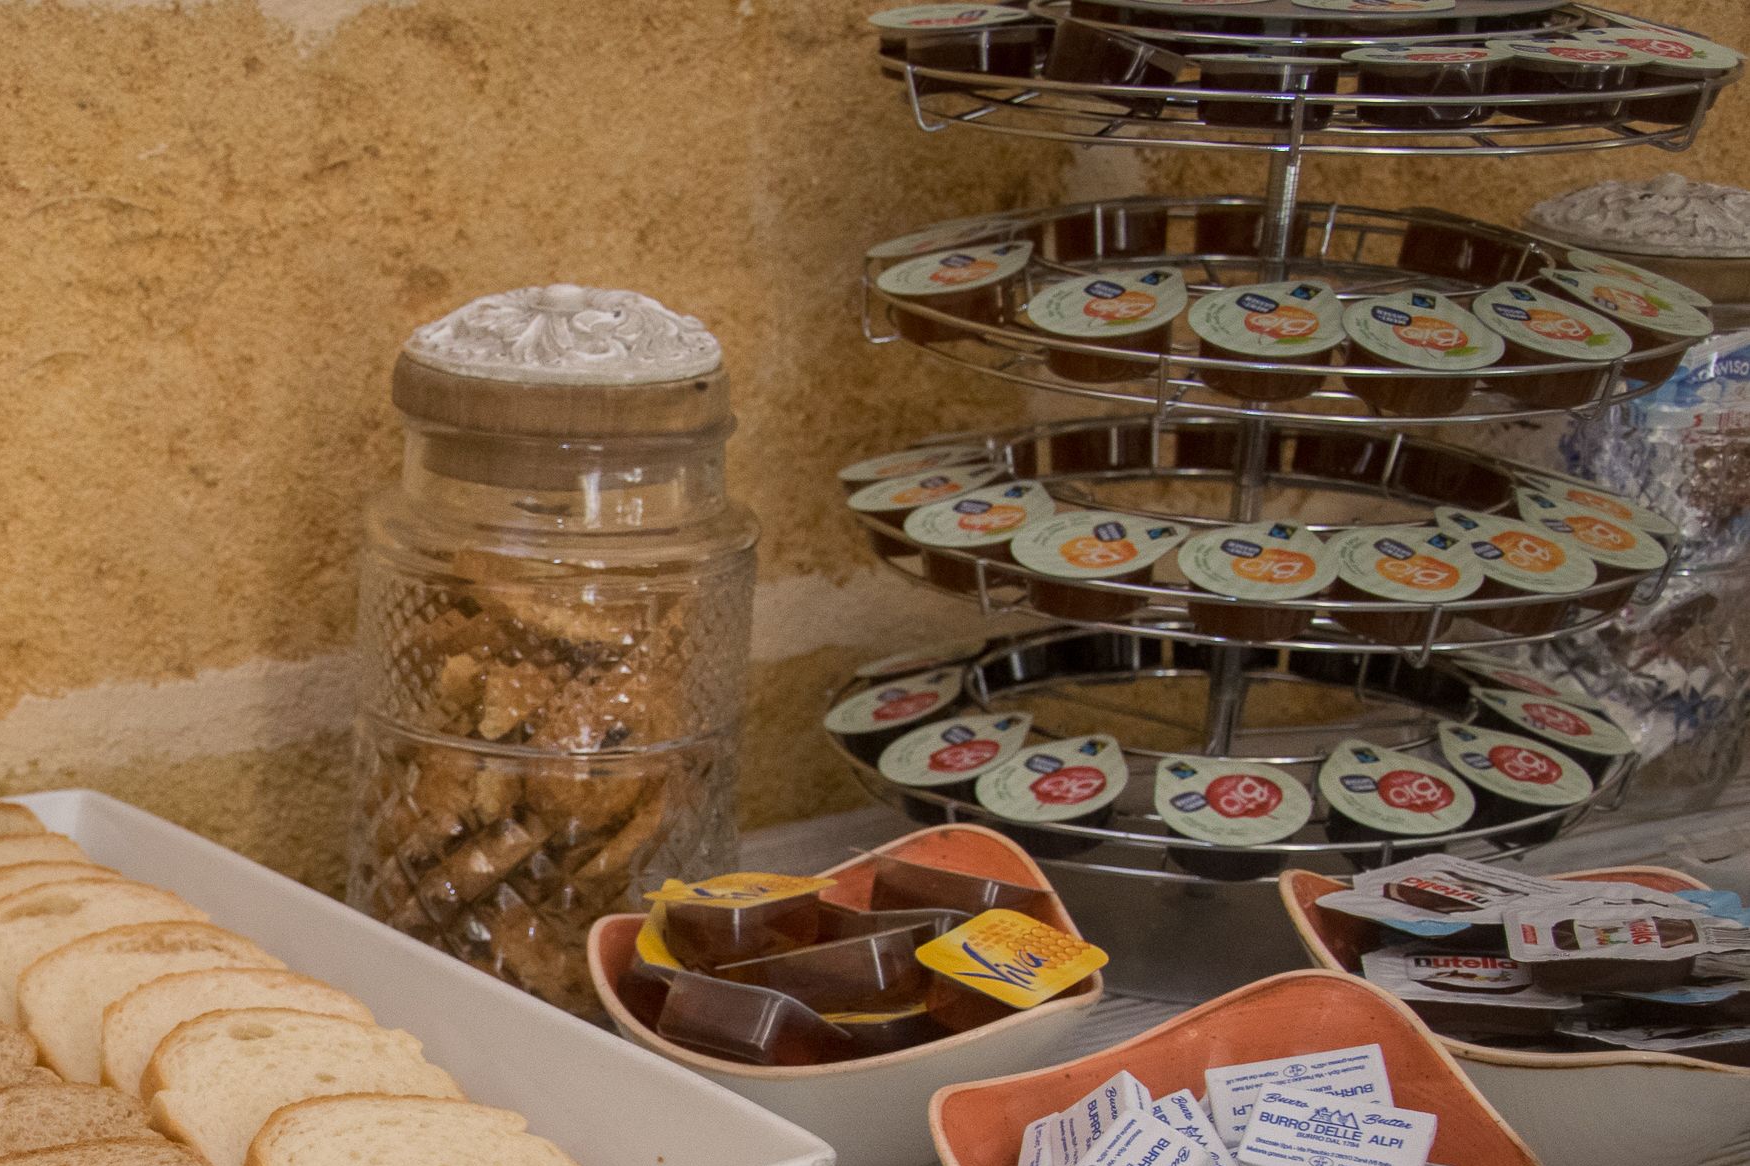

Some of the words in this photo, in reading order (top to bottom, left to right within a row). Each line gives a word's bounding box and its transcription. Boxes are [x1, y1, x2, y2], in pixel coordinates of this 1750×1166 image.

[1504, 749, 1548, 776] Bio
[1219, 776, 1269, 813] Bio
[1389, 776, 1442, 804] Bio
[1401, 876, 1490, 904] nutella
[953, 942, 1048, 991] Viva
[1413, 956, 1519, 970] nutella
[1263, 1093, 1309, 1108] Burro
[1087, 1099, 1102, 1141] BURRO
[1259, 1112, 1310, 1131] BURRO
[1314, 1125, 1363, 1142] DELLE
[1368, 1135, 1403, 1149] ALPI
[1362, 1114, 1413, 1130] Butter
